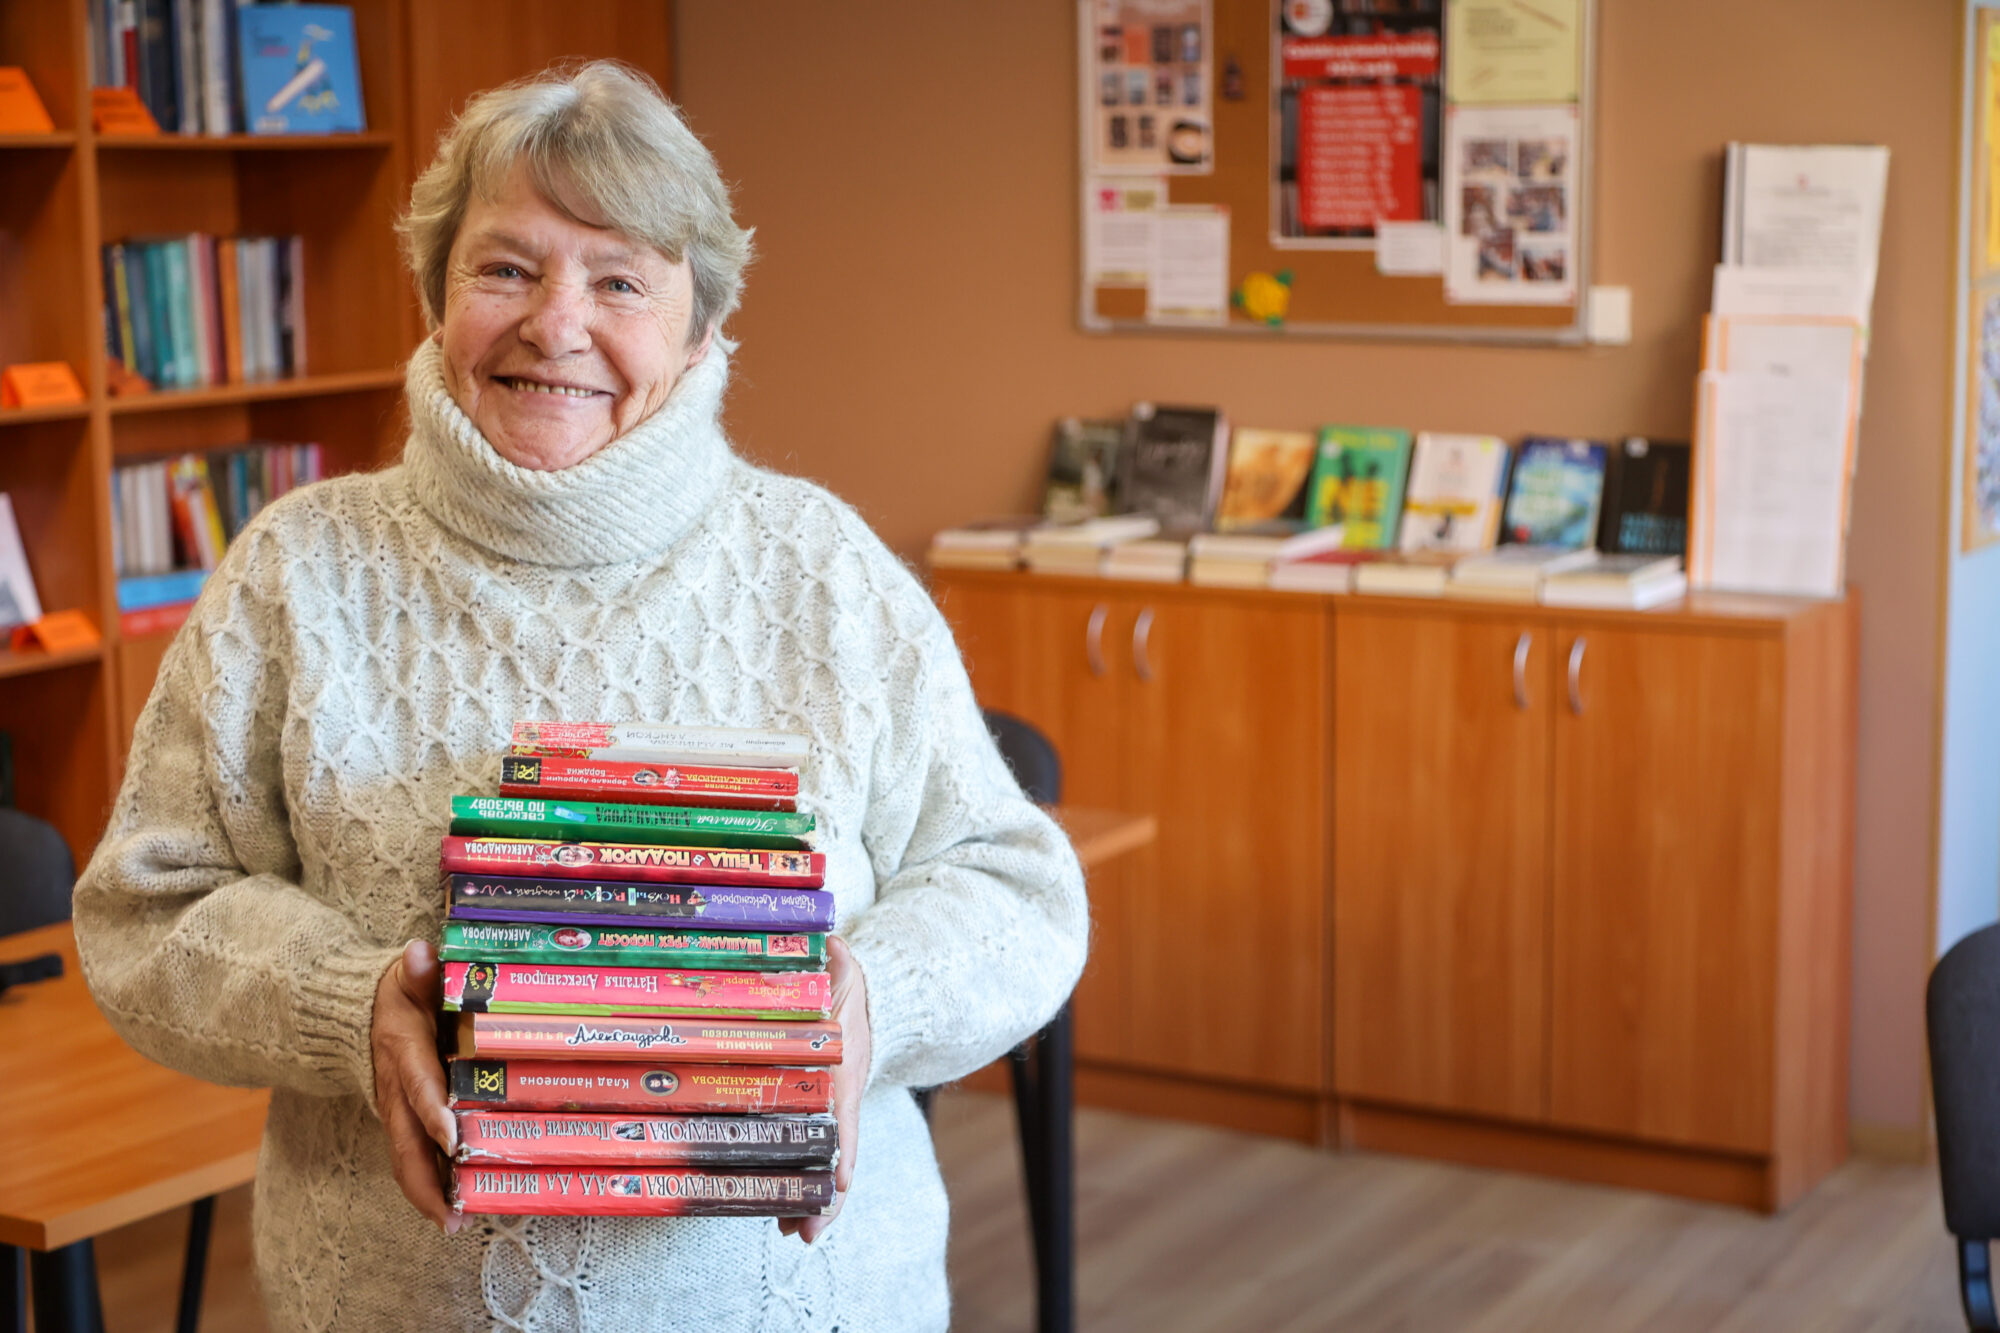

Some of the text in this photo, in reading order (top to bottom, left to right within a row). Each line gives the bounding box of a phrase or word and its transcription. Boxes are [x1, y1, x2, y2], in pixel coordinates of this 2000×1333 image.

[686, 774, 760, 784] АЛЕКСАНДРОВА
[469, 798, 545, 812] ПО ВЫЗОВУ
[478, 810, 545, 822] СВЕКРОВЬ
[595, 806, 778, 832] Наталья АЛЕКСАНДРОВА
[464, 842, 534, 856] АЛЕКСАНДРОВА
[598, 848, 690, 866] ПОДАРОК
[707, 852, 763, 872] ТЕЩА
[514, 884, 560, 897] попугай
[711, 893, 816, 912] Наталья Александрова
[462, 926, 531, 941] АЛЕКСАНДРОВА
[598, 932, 655, 947] ПОРОСЯТ
[657, 934, 689, 948] ТРЕХ
[510, 970, 658, 993] Наталья Александрова
[568, 1025, 685, 1048] Александрова
[478, 1070, 499, 1092] &
[519, 1076, 629, 1090] Клад Наполеона
[692, 1075, 784, 1086] АЛЕКСАНДРОВА
[716, 1086, 761, 1097] Наталья
[478, 1119, 542, 1140] ФАРАОНА
[648, 1120, 806, 1143] Н. АЛЕКСАНДРОВА
[474, 1171, 540, 1194] ВИНЧИ
[578, 1171, 608, 1196] АД
[644, 1174, 780, 1200] АЛЕКСАНДРОВА
[782, 1177, 802, 1200] Н.
